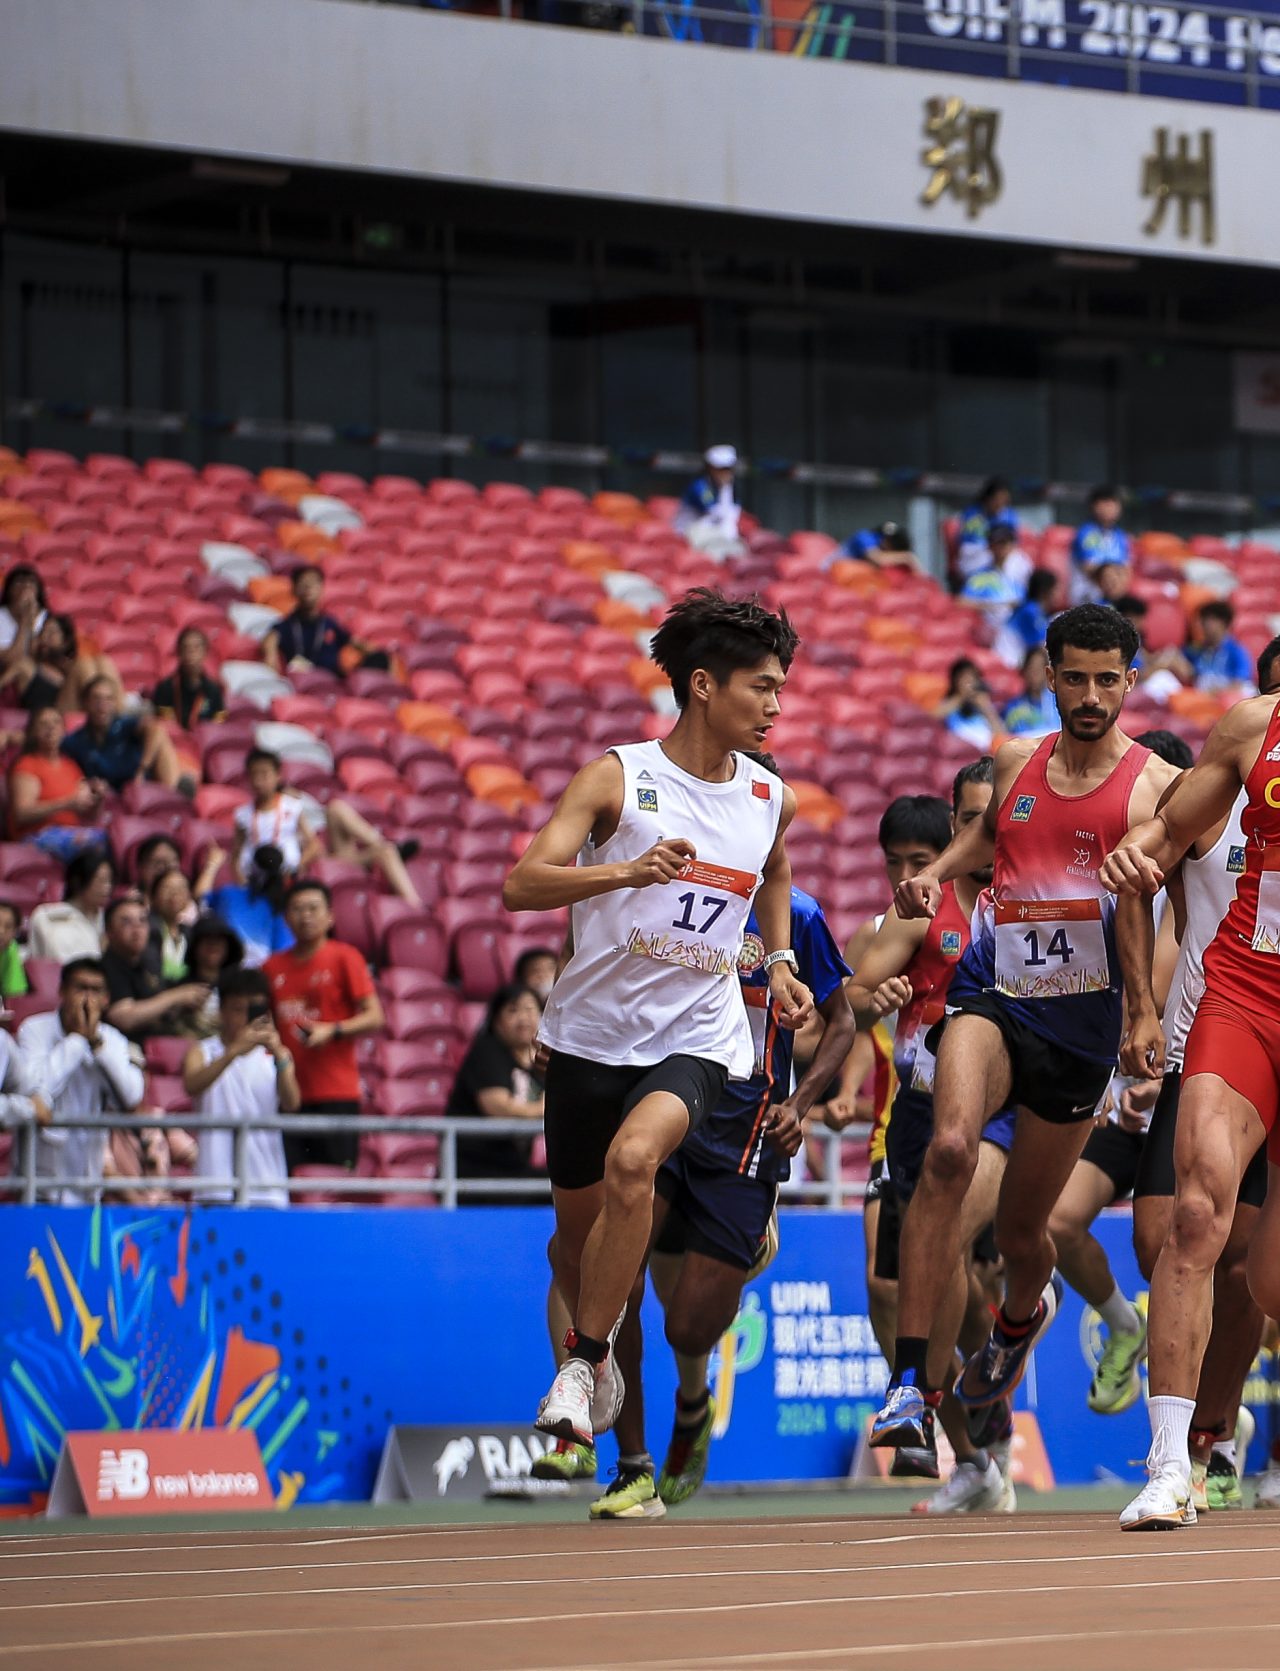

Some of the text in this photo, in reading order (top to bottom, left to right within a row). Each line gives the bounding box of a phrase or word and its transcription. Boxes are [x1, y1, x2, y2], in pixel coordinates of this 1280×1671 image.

[639, 801, 658, 811] UIPM
[672, 891, 728, 934] 17
[1023, 928, 1074, 966] 14
[187, 1469, 260, 1498] balance
